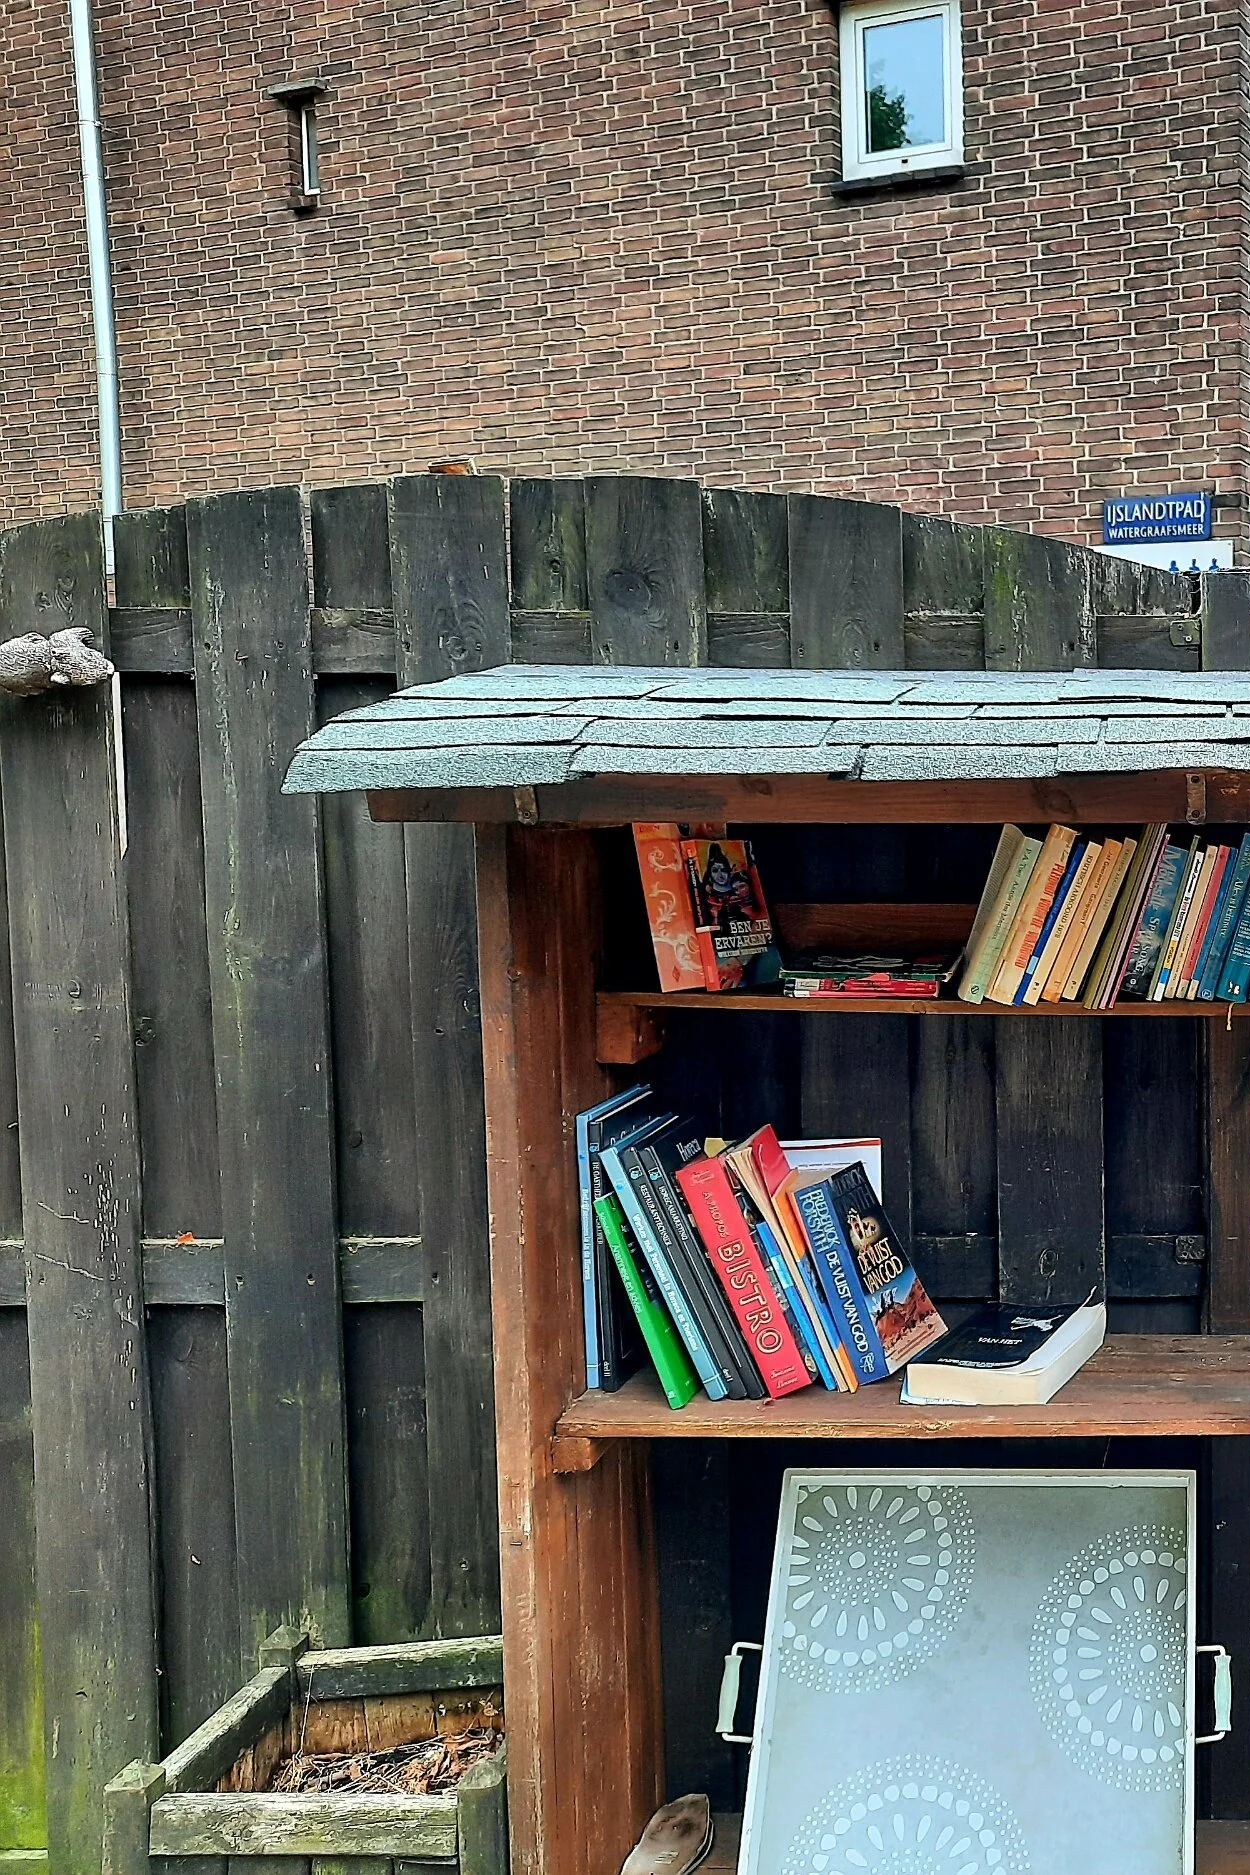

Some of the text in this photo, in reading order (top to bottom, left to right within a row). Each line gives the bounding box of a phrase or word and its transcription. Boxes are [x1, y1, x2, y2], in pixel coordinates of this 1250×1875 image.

[1107, 500, 1205, 526] IJSLANDTPAD
[1108, 523, 1205, 540] WATERGRAAFSMEER
[714, 932, 772, 949] ERVAREN?
[729, 918, 771, 934] BEN JE
[676, 1138, 701, 1162] Horeca
[707, 1200, 730, 1238] PROPOS
[800, 1193, 829, 1254] FORSYTH
[808, 1189, 839, 1247] FREDERICK
[610, 1243, 634, 1282] Anamnese
[631, 1213, 648, 1239] Werken
[666, 1290, 682, 1314] Horeca
[857, 1237, 891, 1275] DE VUIST
[863, 1255, 904, 1294] VAN GOD
[625, 1280, 634, 1292] en
[628, 1290, 643, 1314] advies
[716, 1238, 784, 1355] BISTRO
[824, 1250, 870, 1353] DE VUIST VAN GOD
